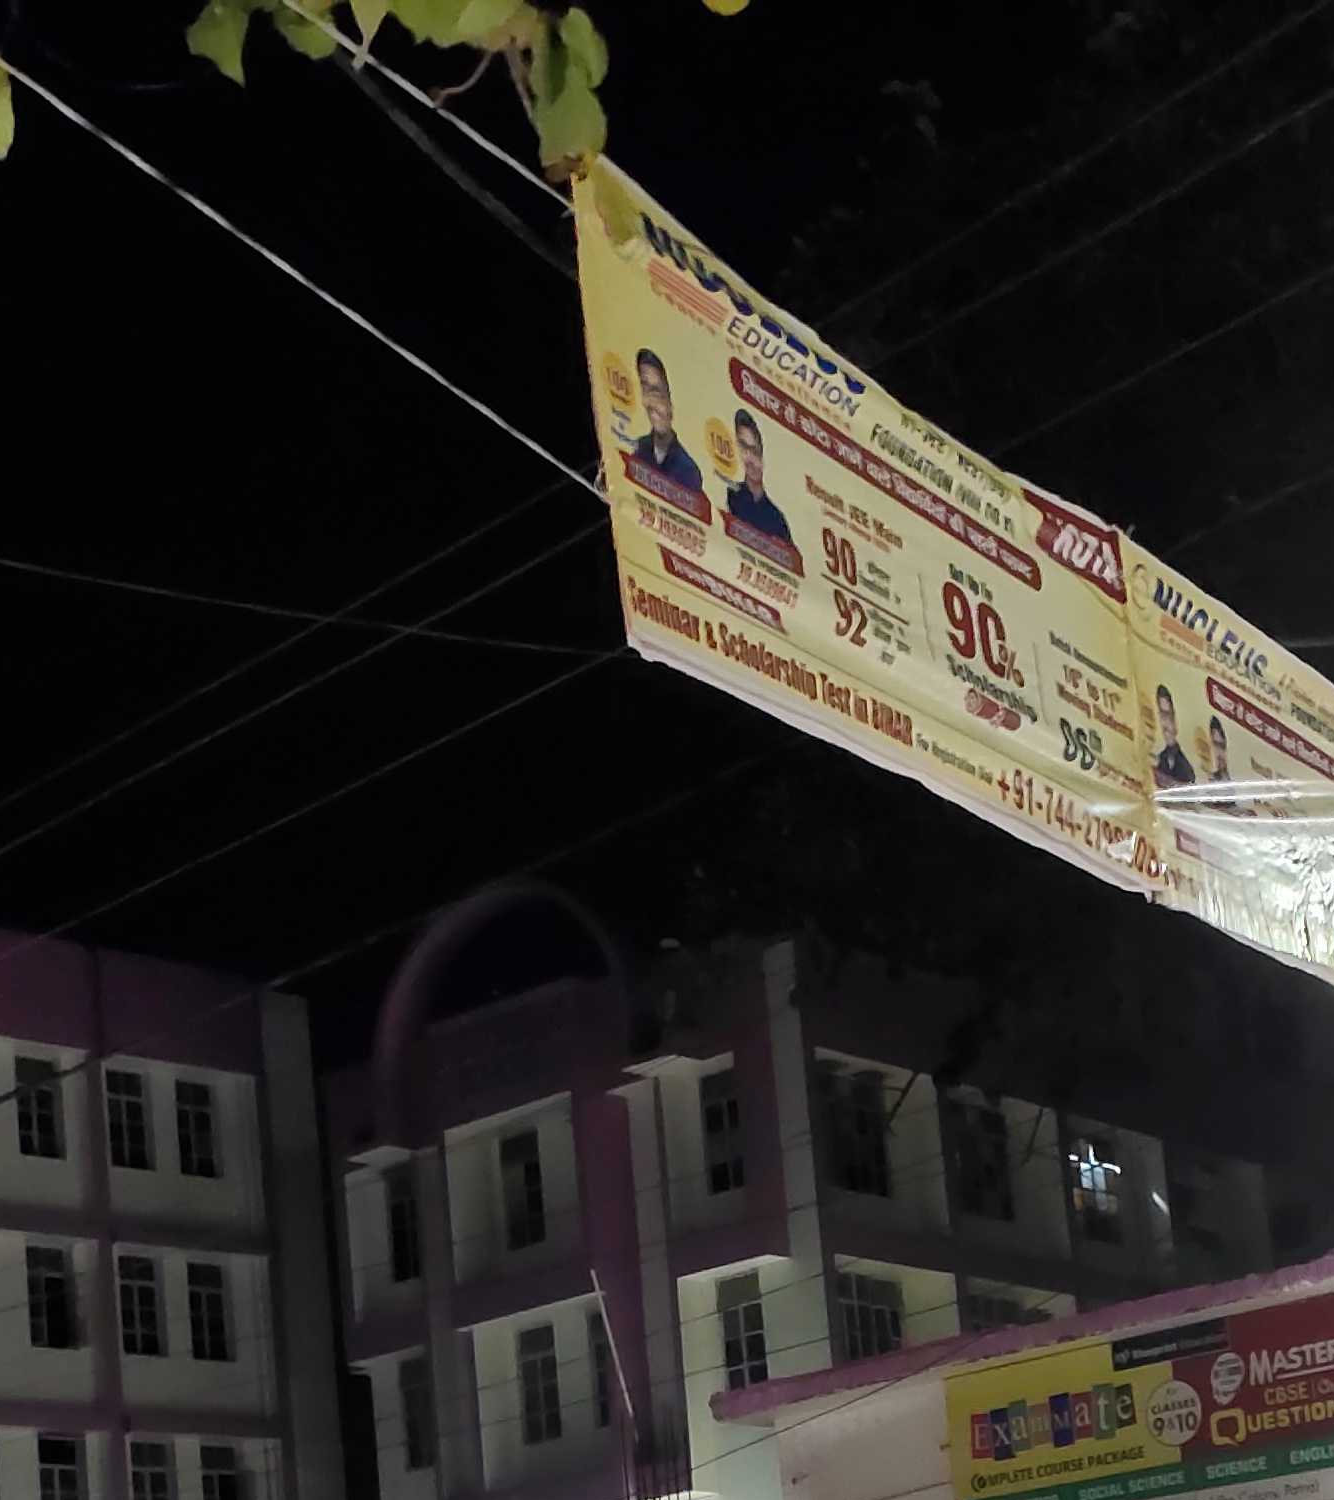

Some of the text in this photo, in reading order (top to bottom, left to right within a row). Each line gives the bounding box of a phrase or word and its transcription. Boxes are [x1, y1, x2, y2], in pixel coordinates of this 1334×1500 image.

[727, 314, 860, 418] EDUCATION
[848, 501, 870, 530] JEE
[820, 523, 859, 589] 90
[830, 585, 871, 653] 92
[628, 575, 701, 644] Seminar
[717, 619, 818, 704] Scholarship
[819, 671, 852, 718] Test
[852, 688, 869, 726] in
[869, 696, 914, 748] BIHAR
[946, 652, 1038, 727] Scholarship
[1151, 1398, 1196, 1415] CLASSES
[1265, 1381, 1309, 1405] CBSE
[1152, 1417, 1165, 1437] 9
[1175, 1410, 1197, 1433] 10
[971, 1446, 1146, 1493] COMPLETE COURSE PACKAGE
[1128, 1471, 1185, 1491] SCIENCE
[1206, 1456, 1267, 1480] SCIENCE
